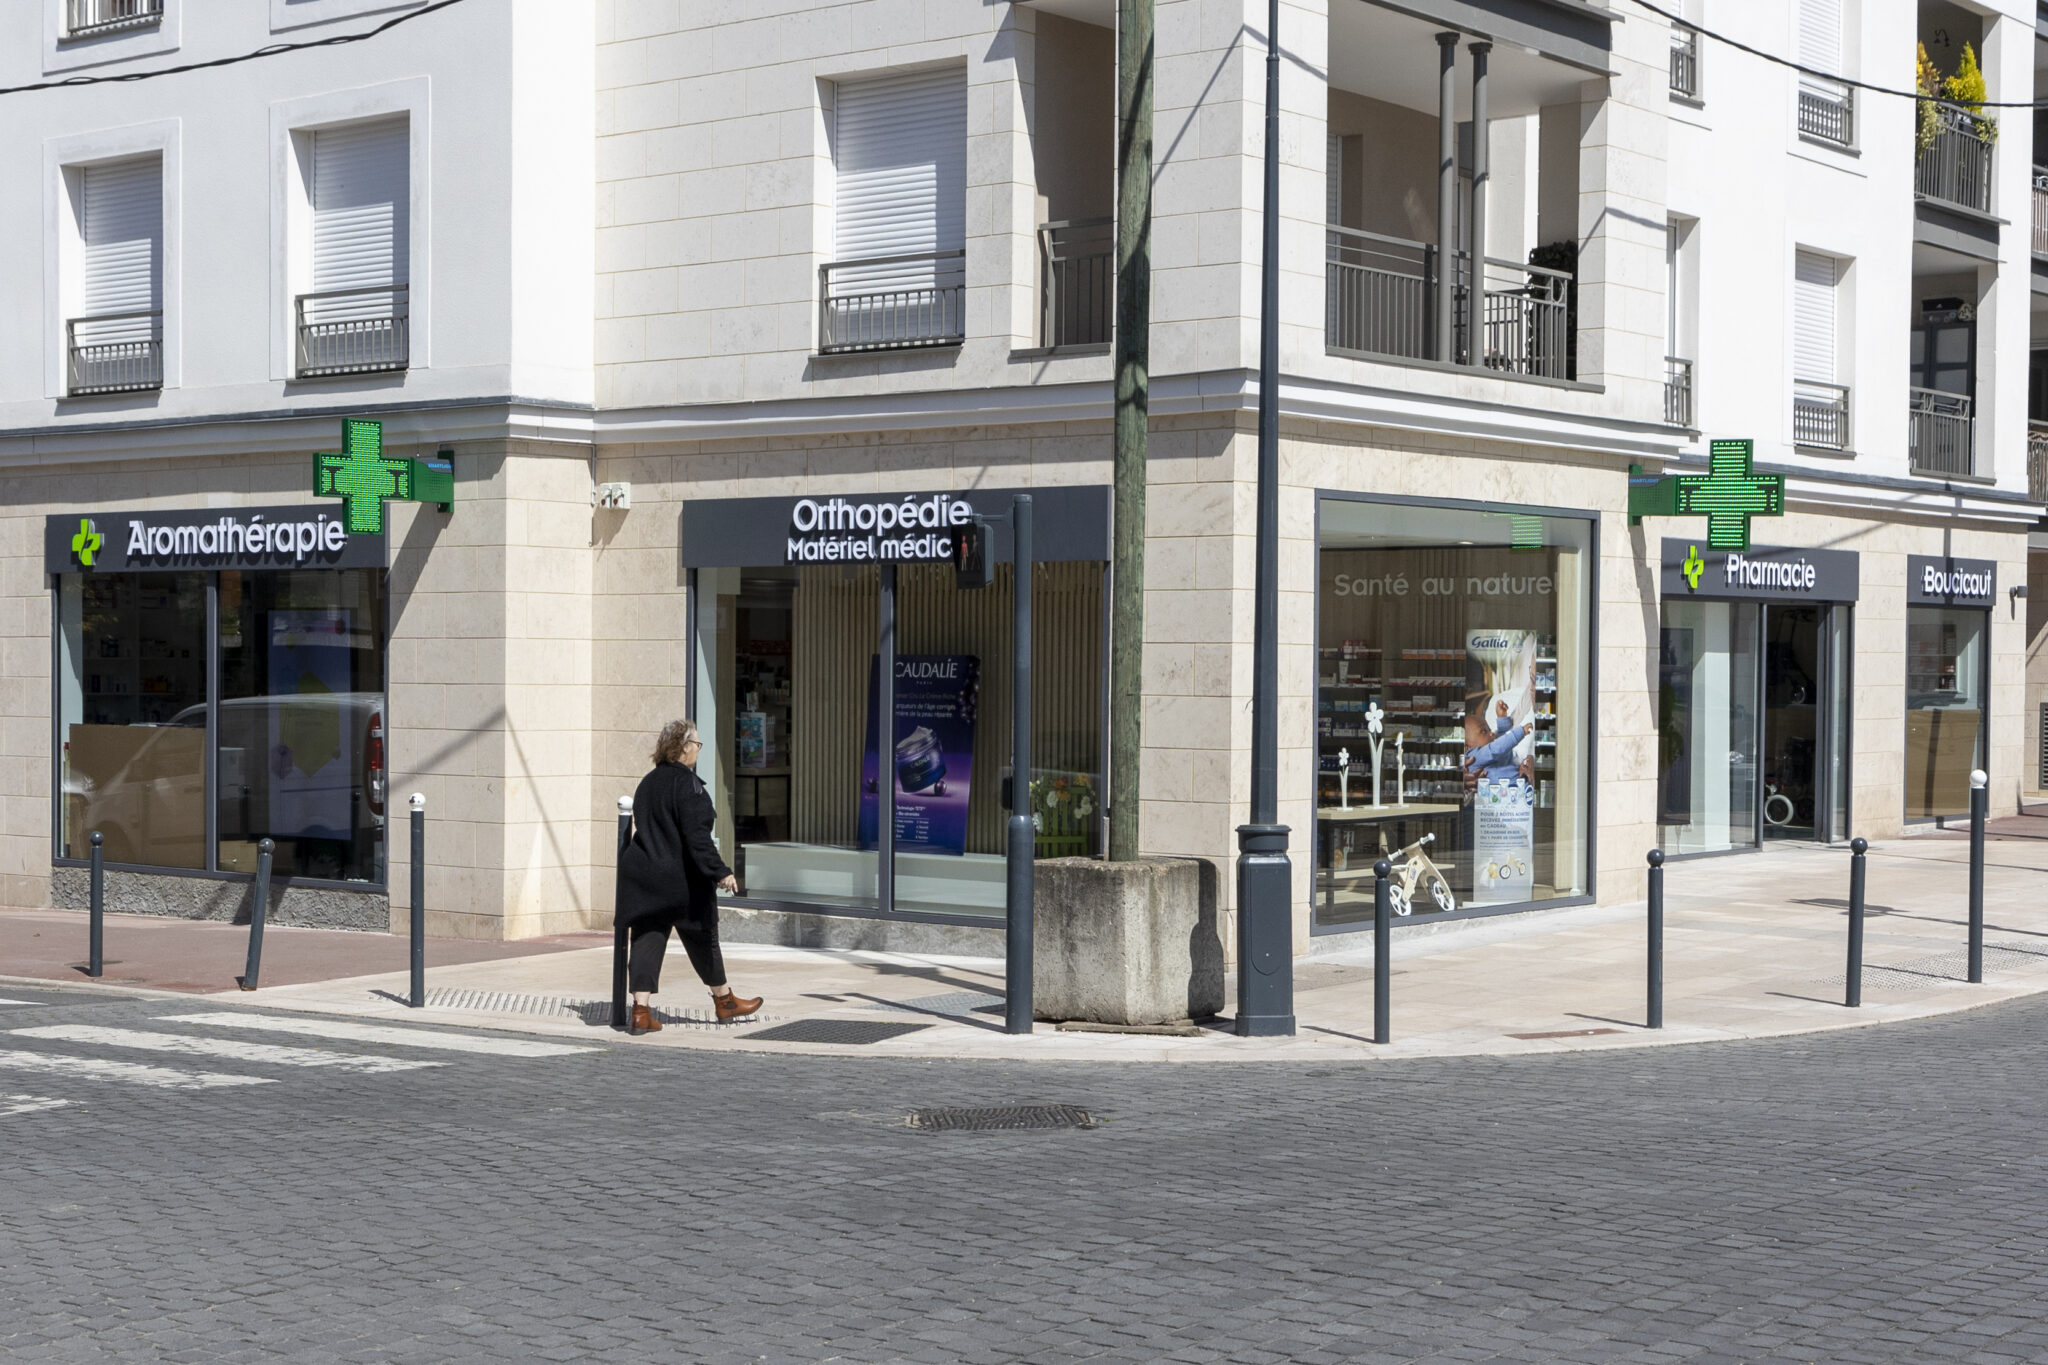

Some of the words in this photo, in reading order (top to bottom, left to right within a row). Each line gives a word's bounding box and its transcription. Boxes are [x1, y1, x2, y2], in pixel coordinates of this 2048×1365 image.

[793, 494, 973, 537] Orthopédie
[126, 514, 348, 561] Aromathérapie
[787, 535, 877, 561] Matériel
[880, 533, 953, 560] médic
[1334, 572, 1409, 596] Santé
[1421, 577, 1454, 596] au
[1726, 553, 1816, 589] Pharmacie
[1922, 564, 1992, 597] Boucicaut
[1471, 636, 1508, 648] Gallia
